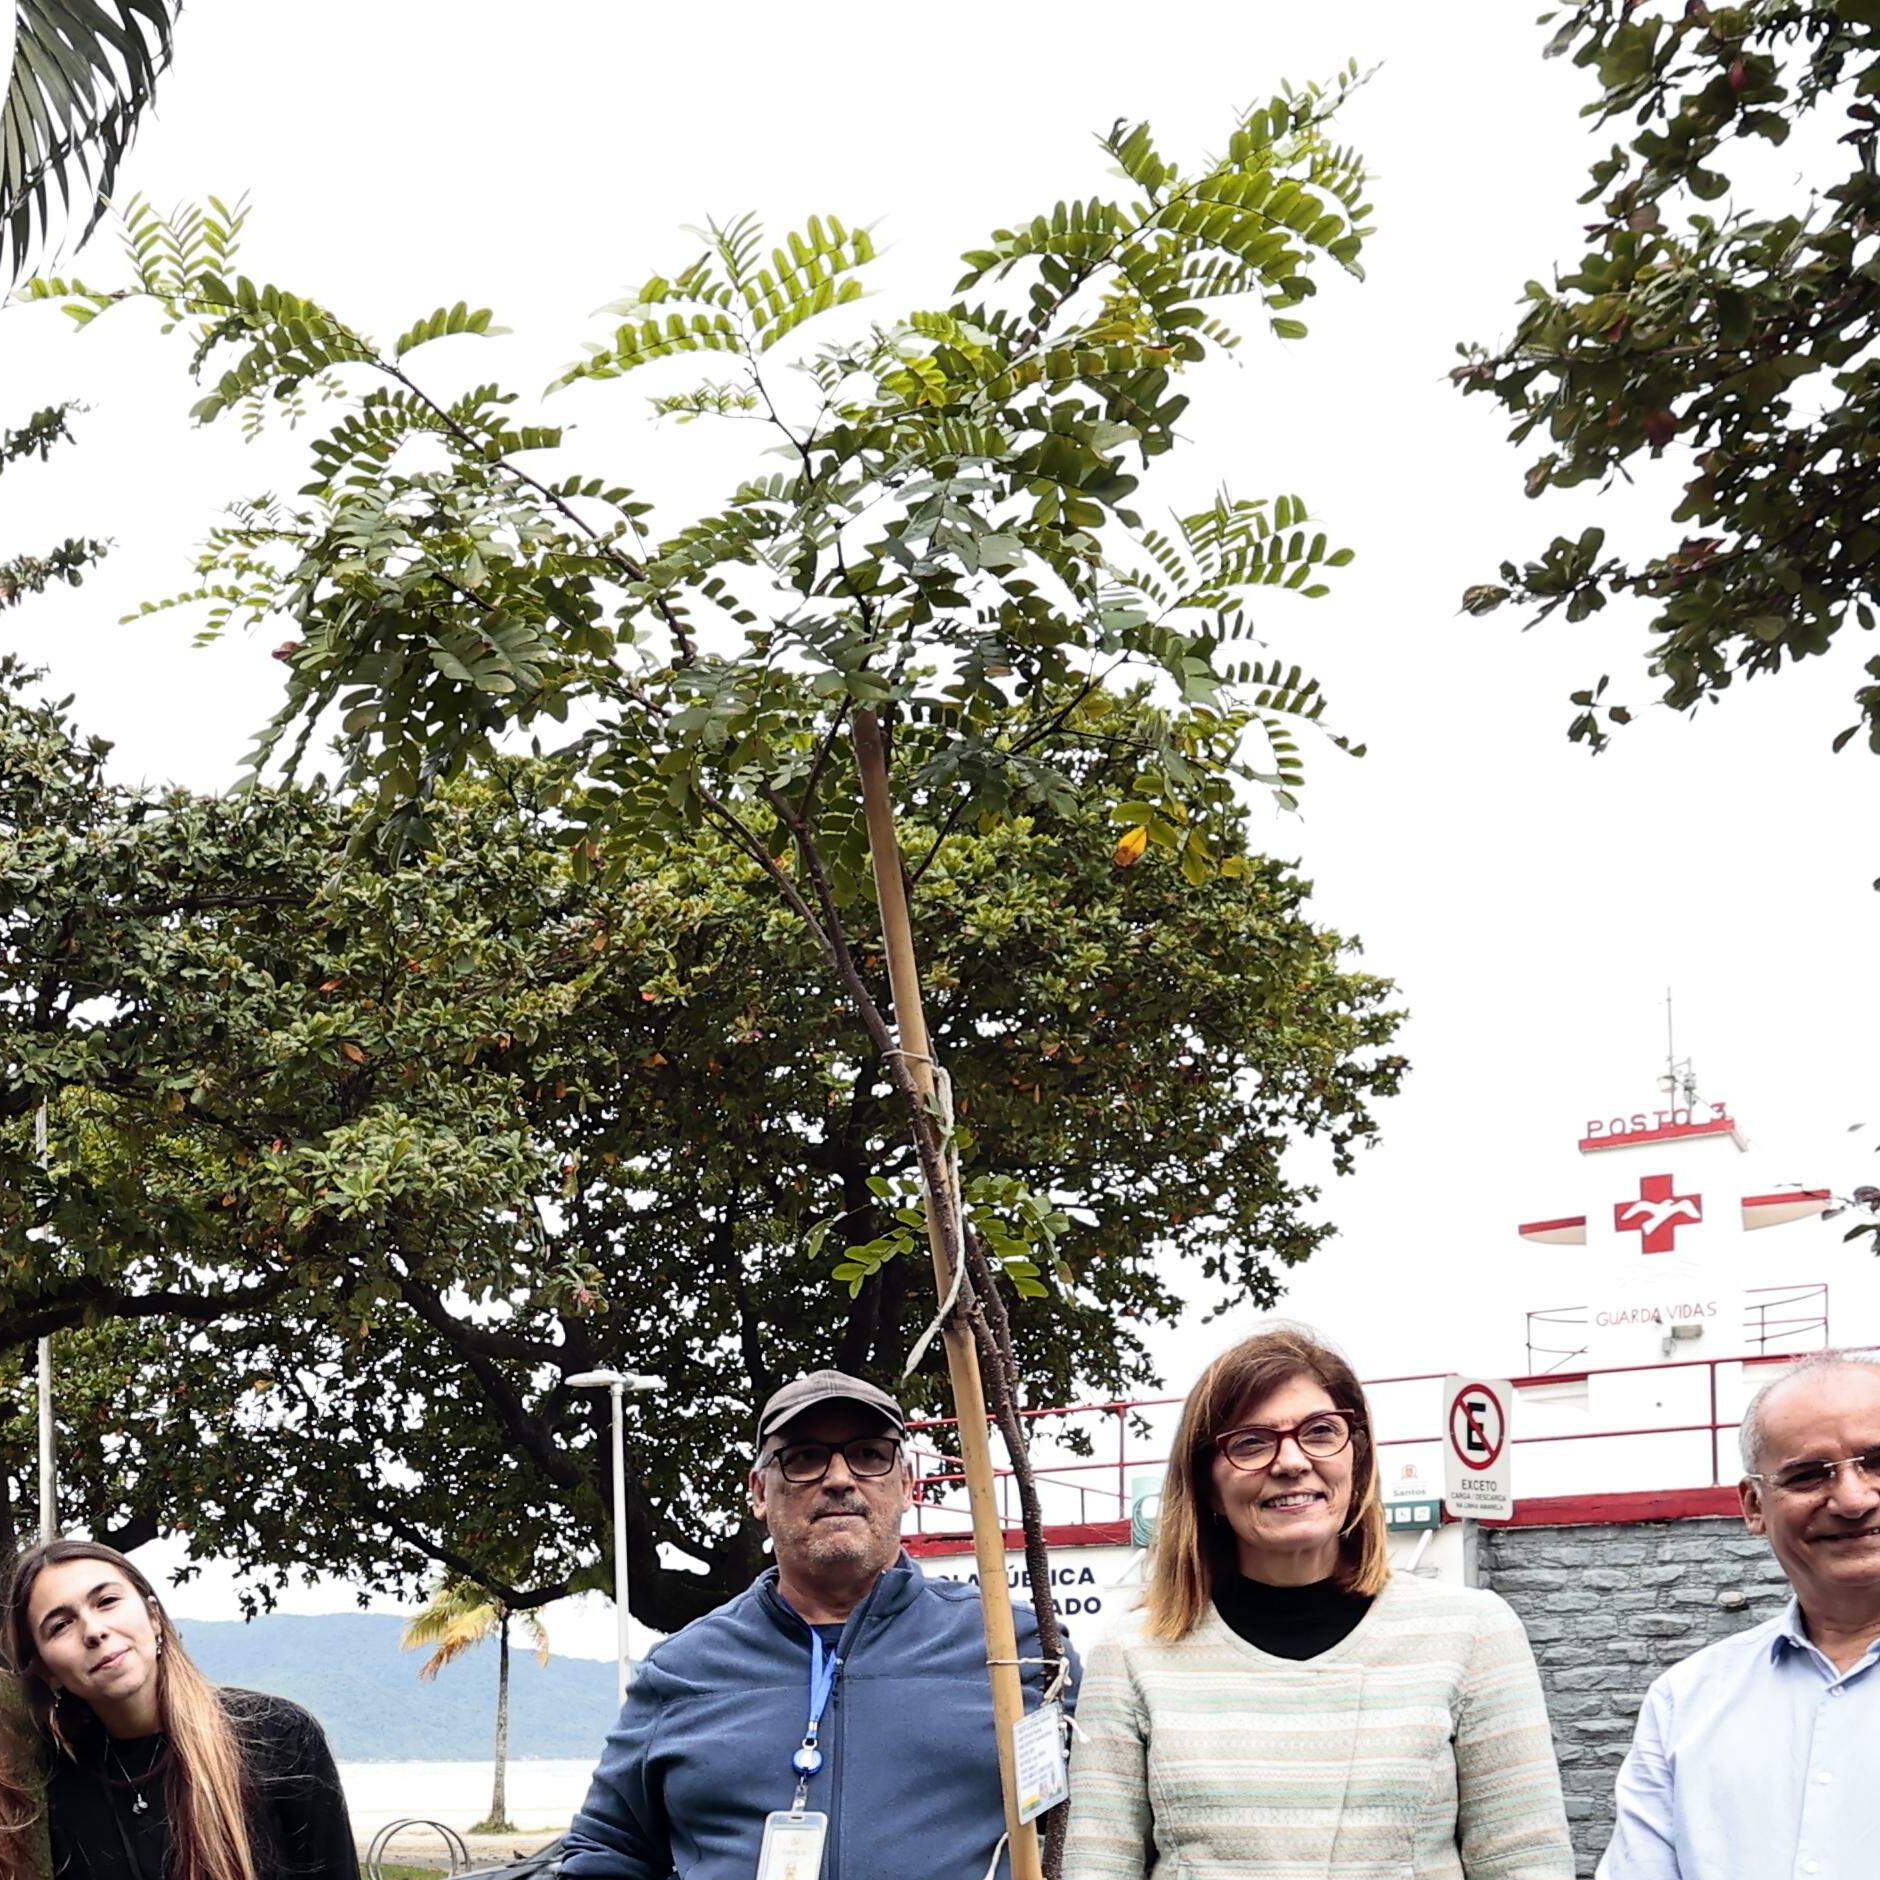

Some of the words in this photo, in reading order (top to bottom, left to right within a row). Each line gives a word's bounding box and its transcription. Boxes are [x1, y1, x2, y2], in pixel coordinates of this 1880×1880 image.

[1587, 1108, 1691, 1138] POSTO
[1710, 1103, 1726, 1121] 3
[1596, 1308, 1661, 1327] GUARDA
[1666, 1302, 1717, 1319] VIDAS
[1461, 1479, 1497, 1492] EXCETO
[1393, 1489, 1427, 1497] Santos
[1451, 1491, 1471, 1500] CARGA
